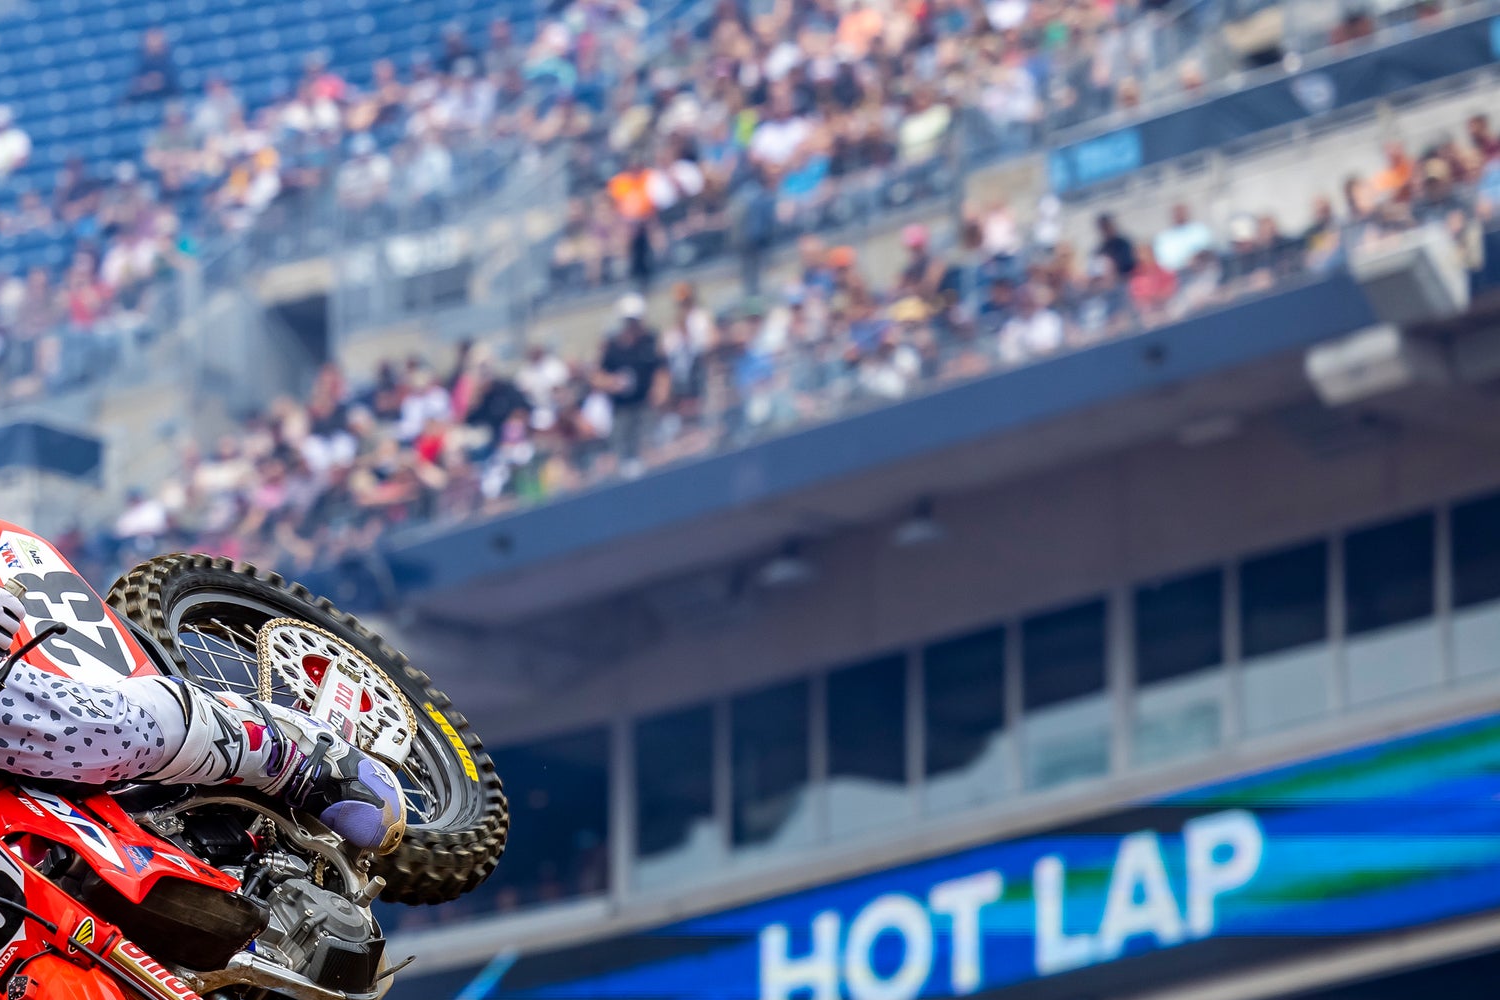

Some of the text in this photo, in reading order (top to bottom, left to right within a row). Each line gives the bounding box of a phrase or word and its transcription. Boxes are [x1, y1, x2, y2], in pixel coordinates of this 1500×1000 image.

[0, 541, 23, 568] AMA
[13, 571, 132, 677] 23
[1032, 808, 1264, 977] LAP
